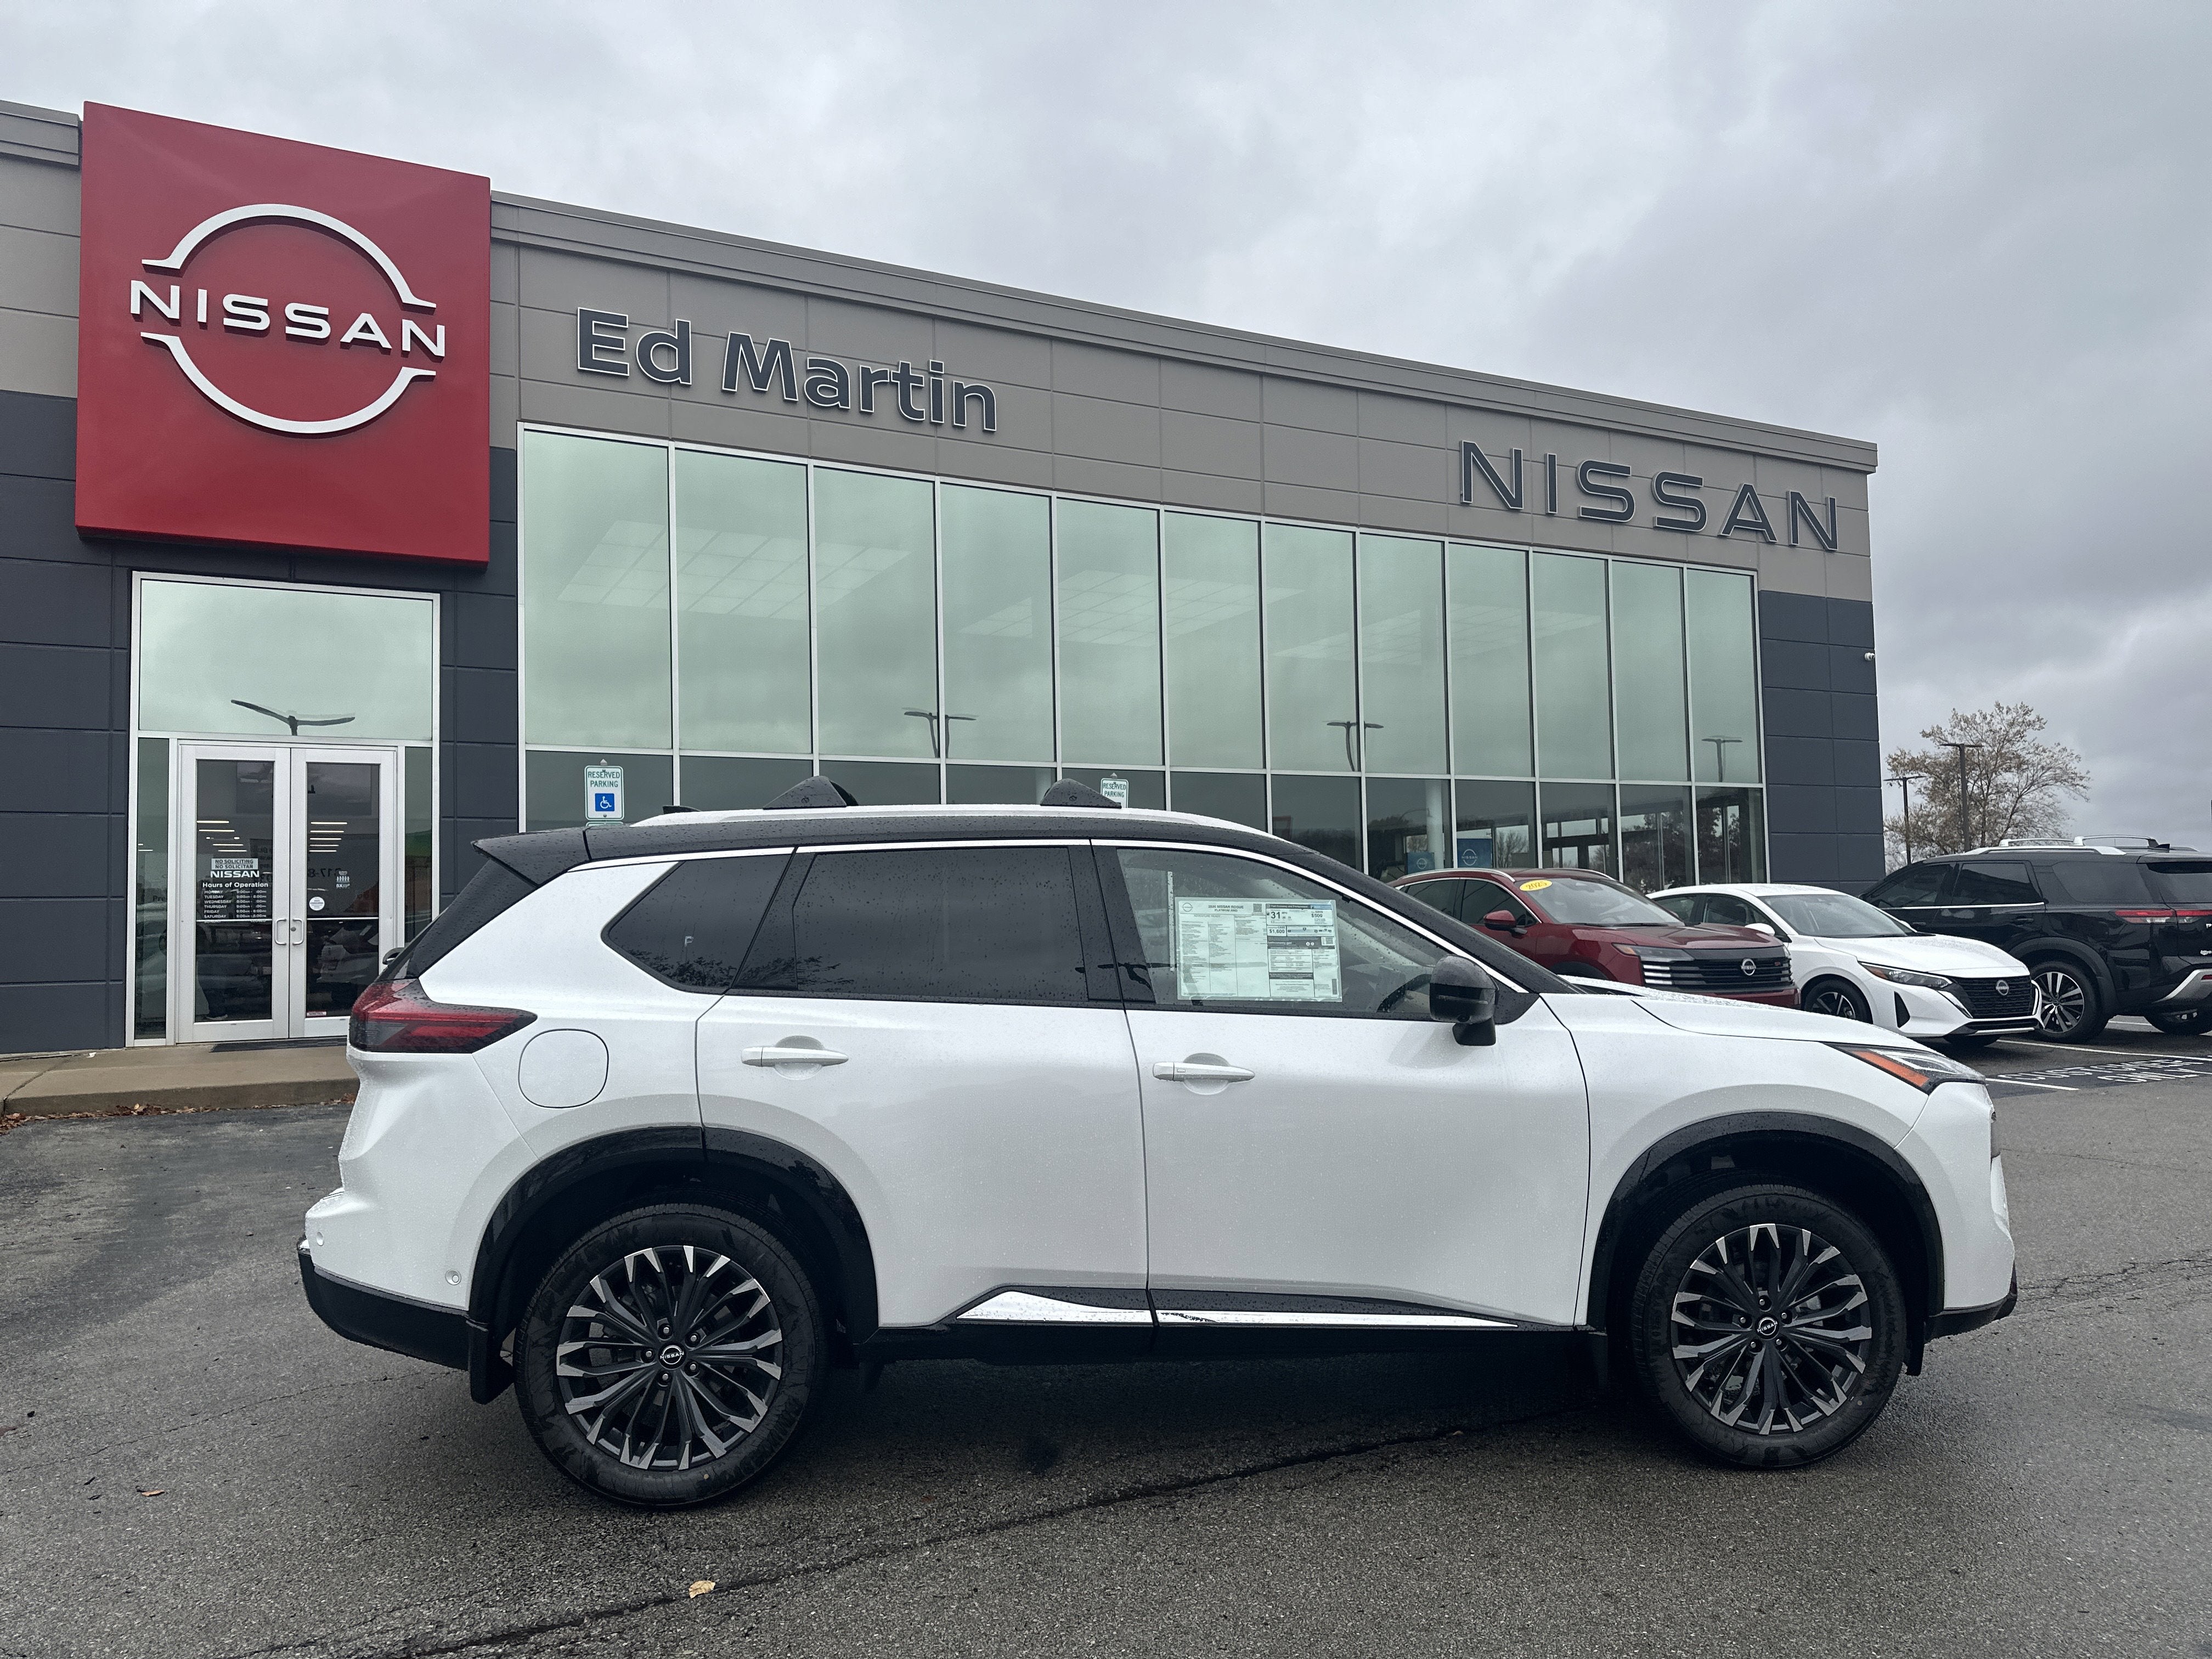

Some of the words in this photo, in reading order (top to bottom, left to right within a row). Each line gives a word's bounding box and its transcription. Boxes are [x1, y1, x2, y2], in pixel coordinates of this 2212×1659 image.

[131, 280, 445, 357] NISSAN
[577, 307, 692, 386] Ed
[721, 332, 997, 432] Martin
[1459, 440, 1838, 551] NISSAN
[659, 1351, 685, 1359] NISSAN
[1757, 1321, 1778, 1333] NISSAN
